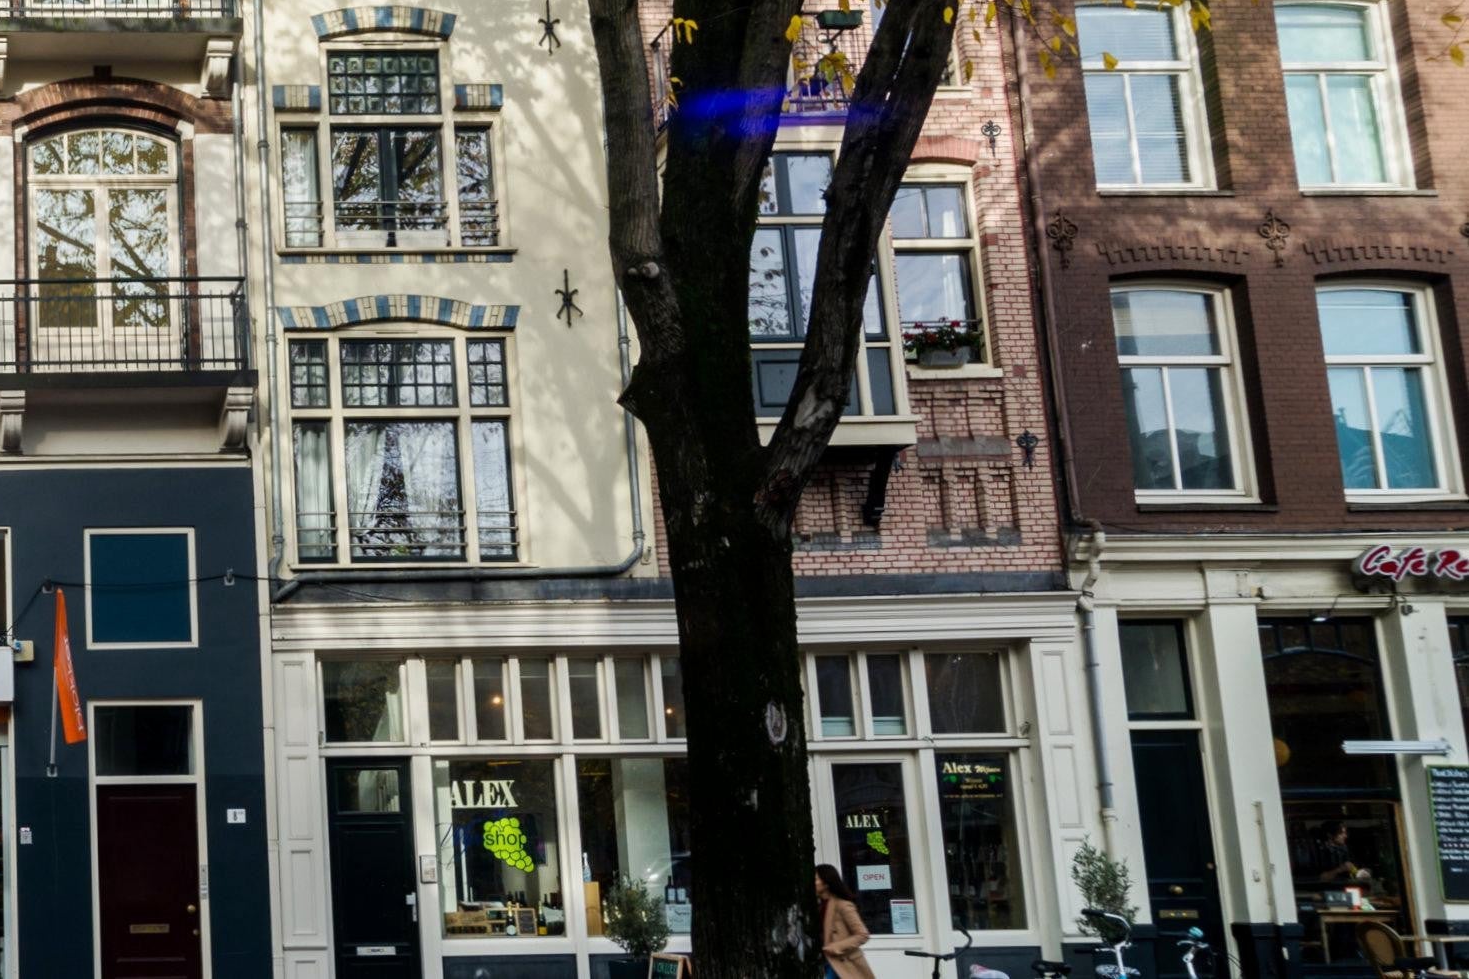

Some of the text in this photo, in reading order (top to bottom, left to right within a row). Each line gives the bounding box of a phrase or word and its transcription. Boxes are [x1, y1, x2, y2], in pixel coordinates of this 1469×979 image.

[451, 779, 519, 809] ALEX
[845, 814, 881, 828] ALEX
[862, 873, 886, 881] OPEN
